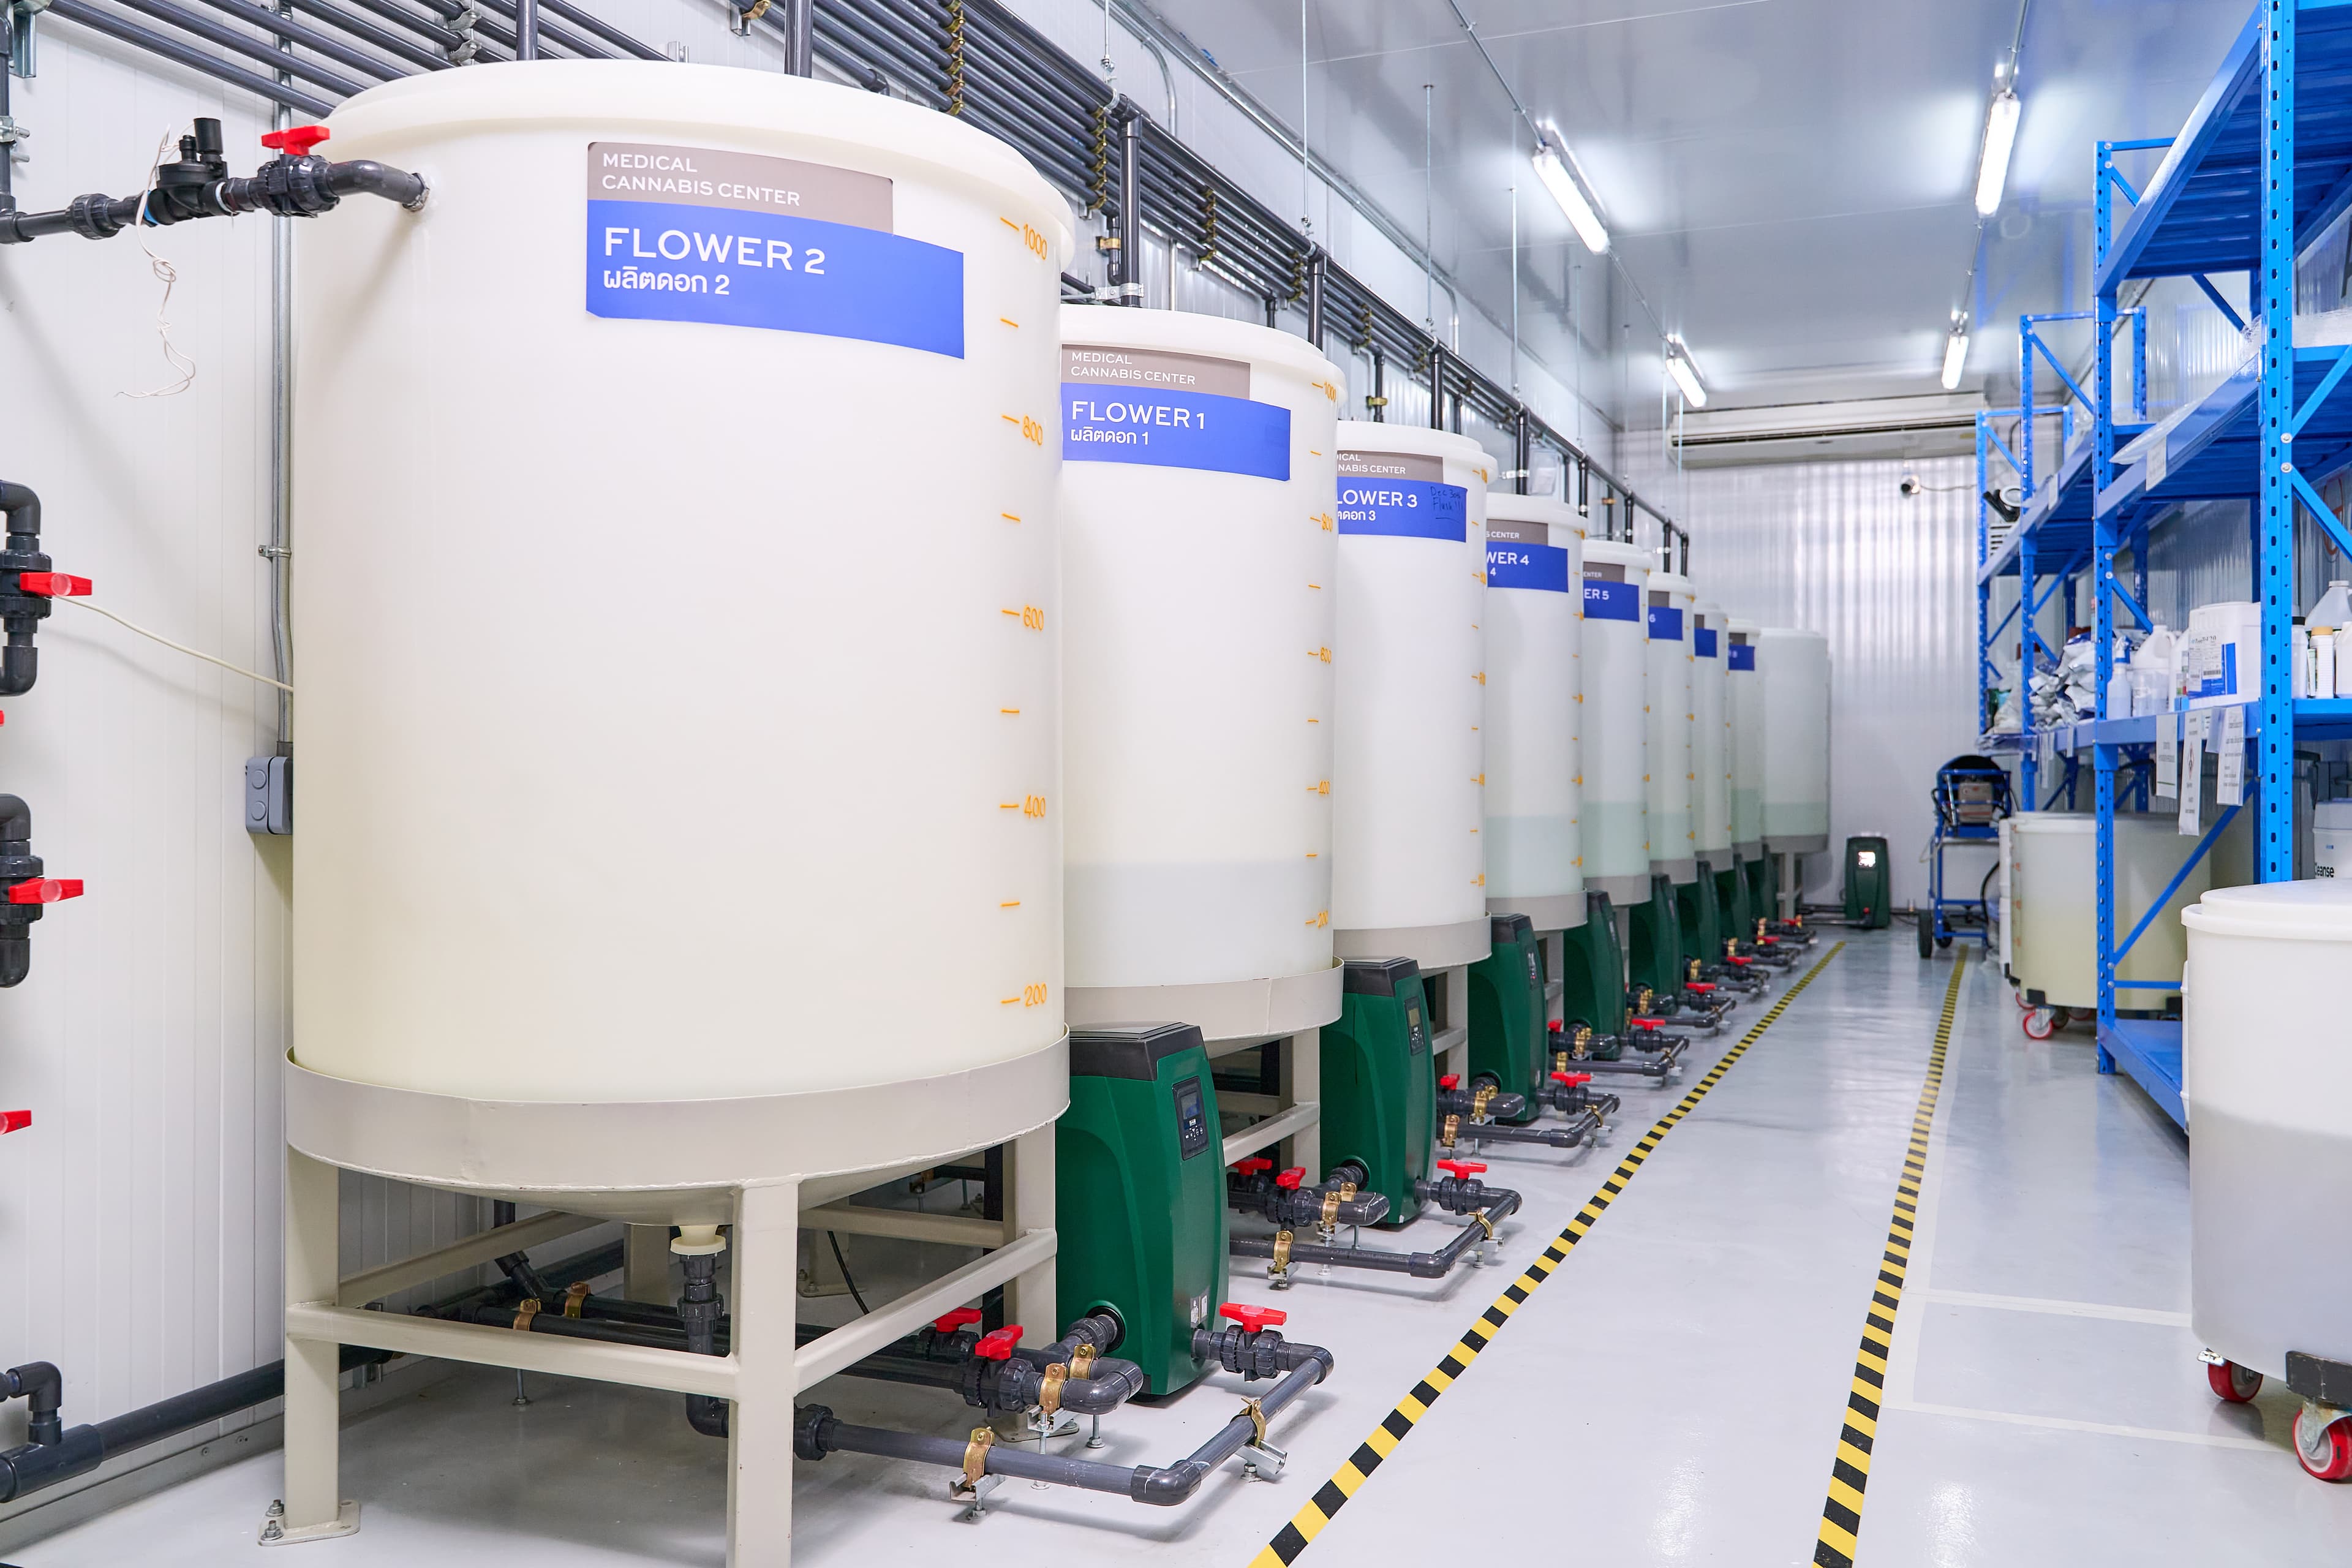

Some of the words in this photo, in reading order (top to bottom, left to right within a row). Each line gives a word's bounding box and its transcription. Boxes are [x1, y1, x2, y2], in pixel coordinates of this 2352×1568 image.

[603, 153, 698, 173] MEDICAL
[602, 175, 714, 196] CANNABIS
[718, 183, 800, 206] CENTER
[605, 227, 793, 271] FLOWER
[804, 248, 826, 275] 2
[1023, 223, 1047, 260] 1000
[603, 265, 707, 293] ผลิตดอก
[714, 274, 730, 295] 2
[1072, 352, 1133, 364] MEDICAL
[1071, 366, 1142, 380] CANNABIS
[1144, 371, 1196, 385] CENTER
[1072, 401, 1190, 428] FLOWER
[1196, 413, 1205, 430] 1
[1022, 414, 1043, 446] 800
[1071, 426, 1137, 445] ผลิตดอก
[1142, 431, 1148, 445] 1
[1370, 465, 1406, 475] CENTER
[1407, 494, 1418, 508] 3
[1368, 510, 1376, 521] 3
[1520, 554, 1529, 565] 4
[1490, 567, 1496, 576] 4
[1602, 590, 1610, 600] 5
[1023, 605, 1044, 631] 600
[1649, 614, 1656, 623] 6
[1023, 794, 1046, 819] 400
[1024, 982, 1047, 1007] 200
